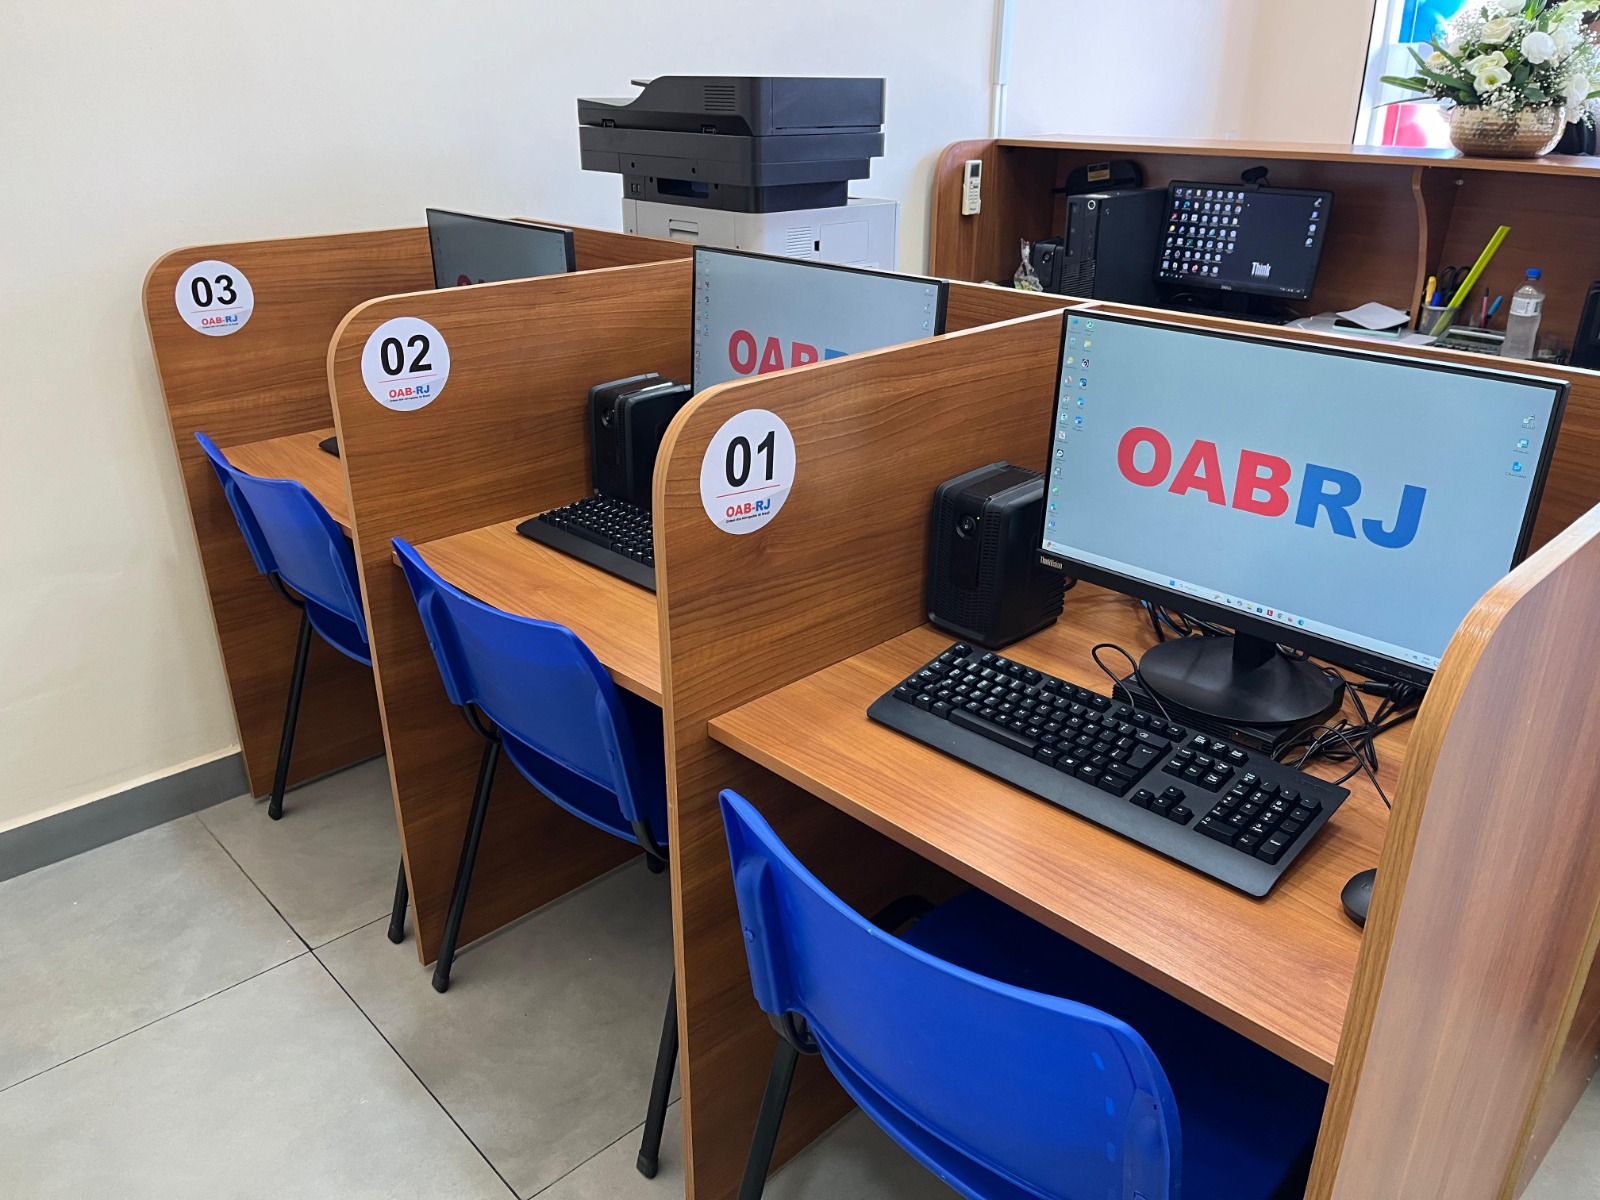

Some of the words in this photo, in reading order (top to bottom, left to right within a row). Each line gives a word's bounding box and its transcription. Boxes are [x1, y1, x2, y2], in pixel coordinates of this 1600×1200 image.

[190, 274, 238, 308] 03
[201, 315, 238, 326] OAB-RJ
[380, 334, 432, 376] 02
[728, 329, 849, 375] OAB
[388, 384, 430, 398] OAB-RJ
[725, 430, 775, 488] 01
[1117, 426, 1427, 548] OABRJ
[725, 498, 771, 518] OAB-RJ
